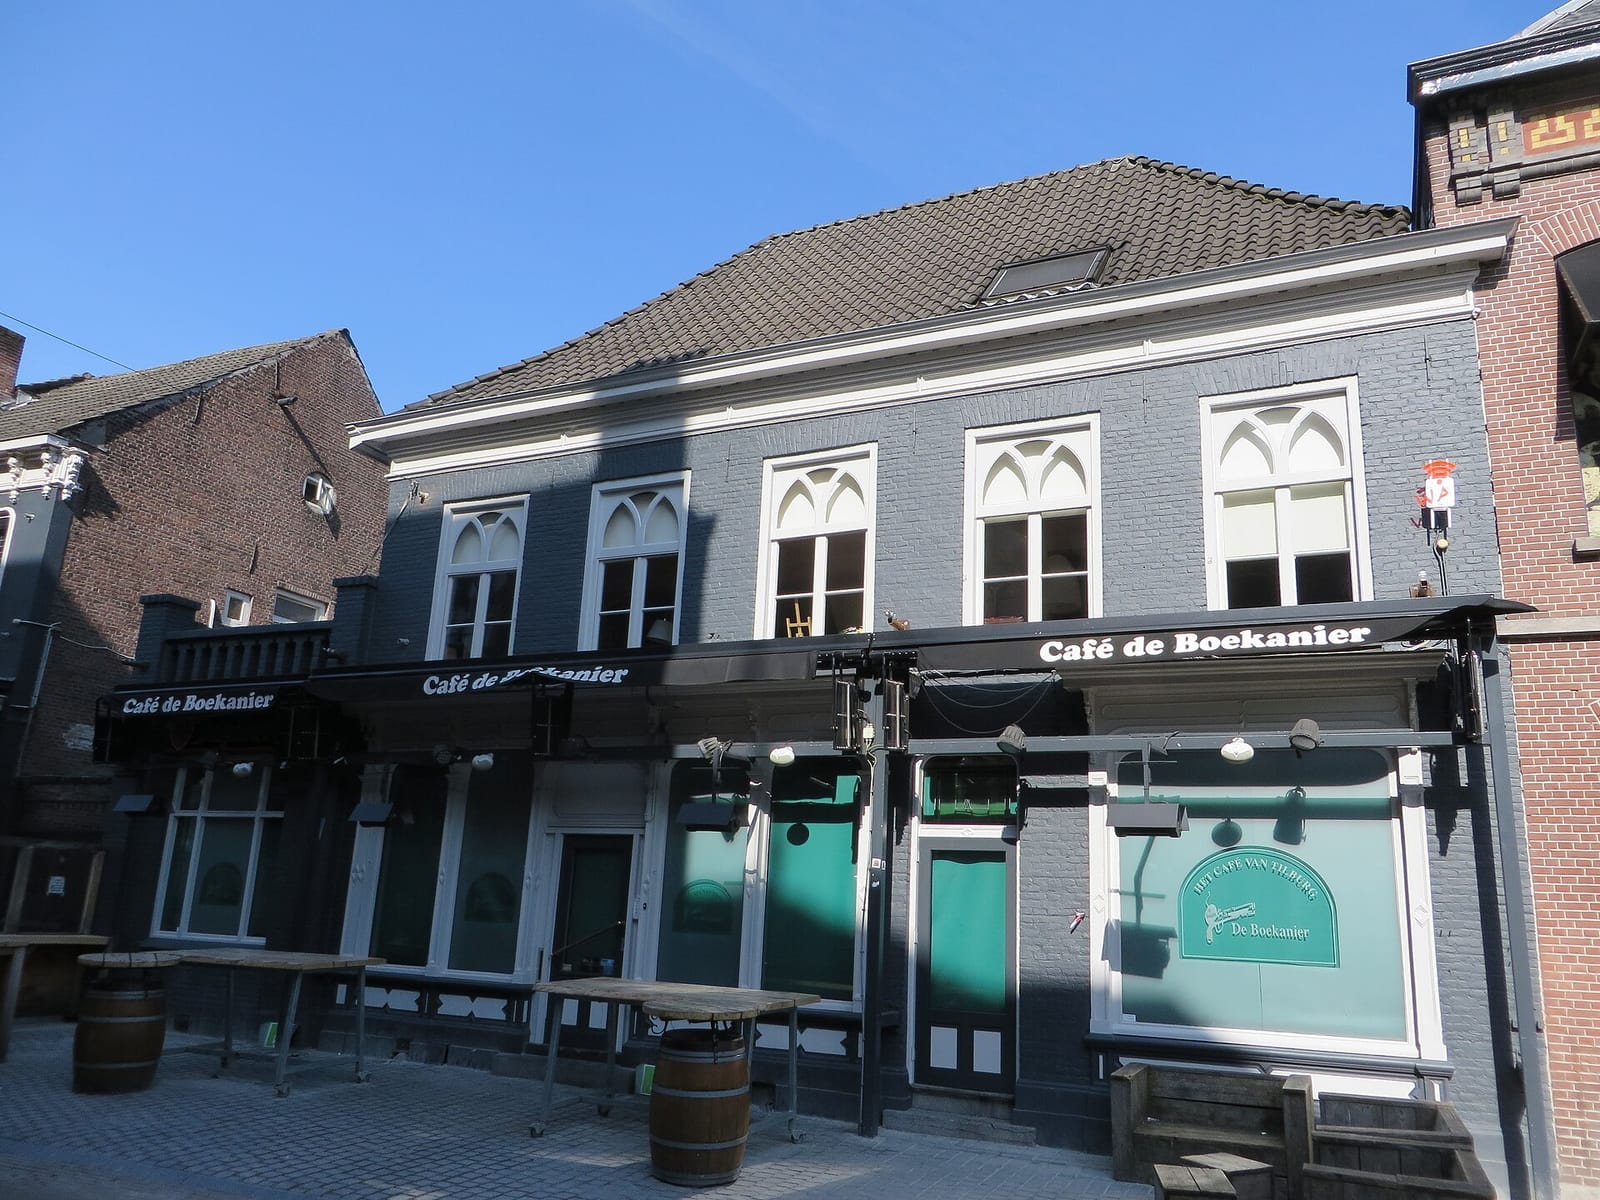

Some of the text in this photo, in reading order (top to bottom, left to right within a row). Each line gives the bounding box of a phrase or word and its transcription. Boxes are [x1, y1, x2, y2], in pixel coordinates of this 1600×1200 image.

[1039, 624, 1372, 663] Café de Boekanier
[423, 673, 472, 695] Café
[472, 673, 499, 690] de
[122, 692, 274, 714] Café de Boekanier
[1194, 857, 1319, 901] HET CAFÉ VAN TILBURG
[1231, 922, 1311, 941] De Boekanier
